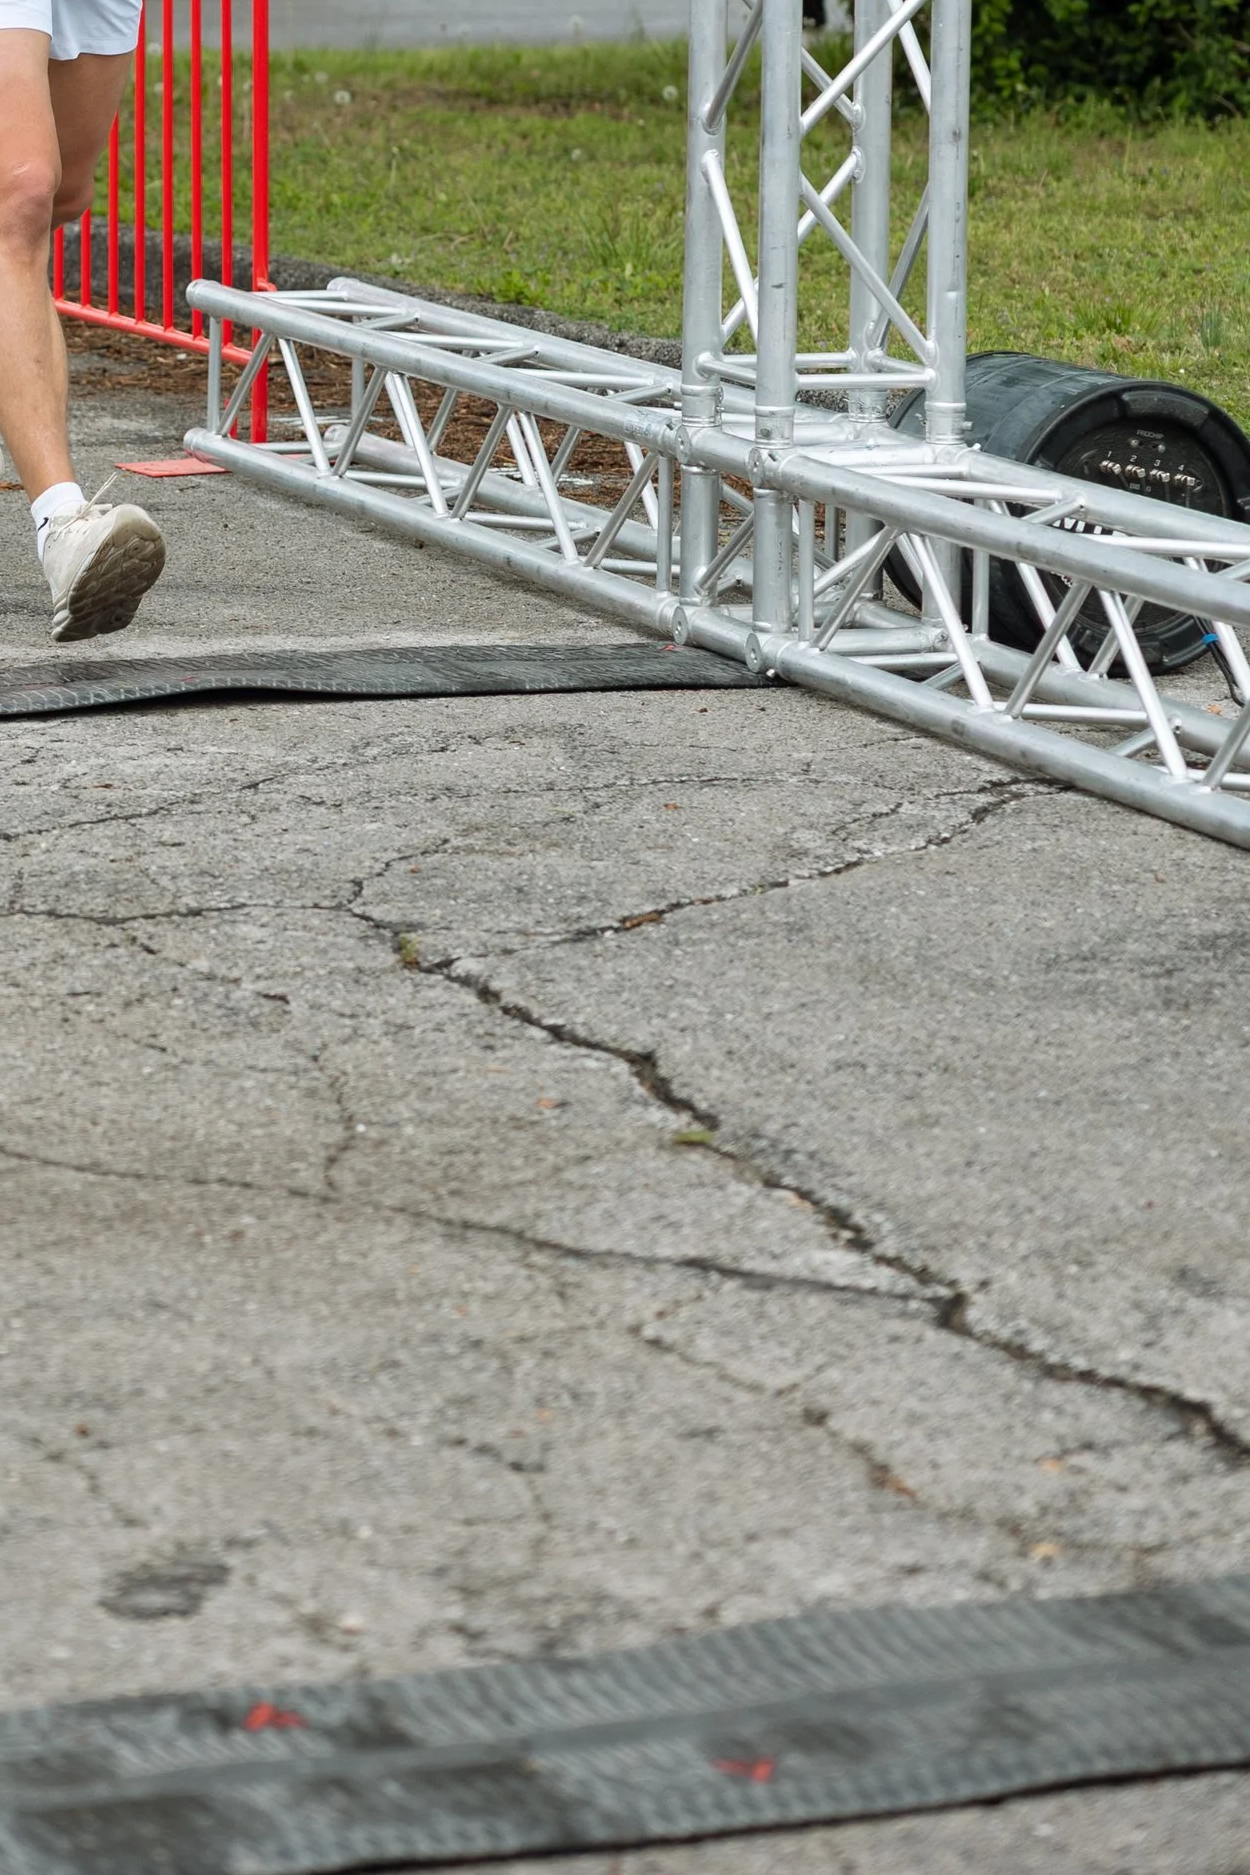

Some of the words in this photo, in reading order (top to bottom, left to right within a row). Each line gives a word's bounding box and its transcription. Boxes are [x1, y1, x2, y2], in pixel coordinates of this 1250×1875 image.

[1107, 450, 1113, 458] 1
[1130, 454, 1138, 463] 2
[1154, 459, 1162, 467] 3
[1177, 464, 1185, 472] 4
